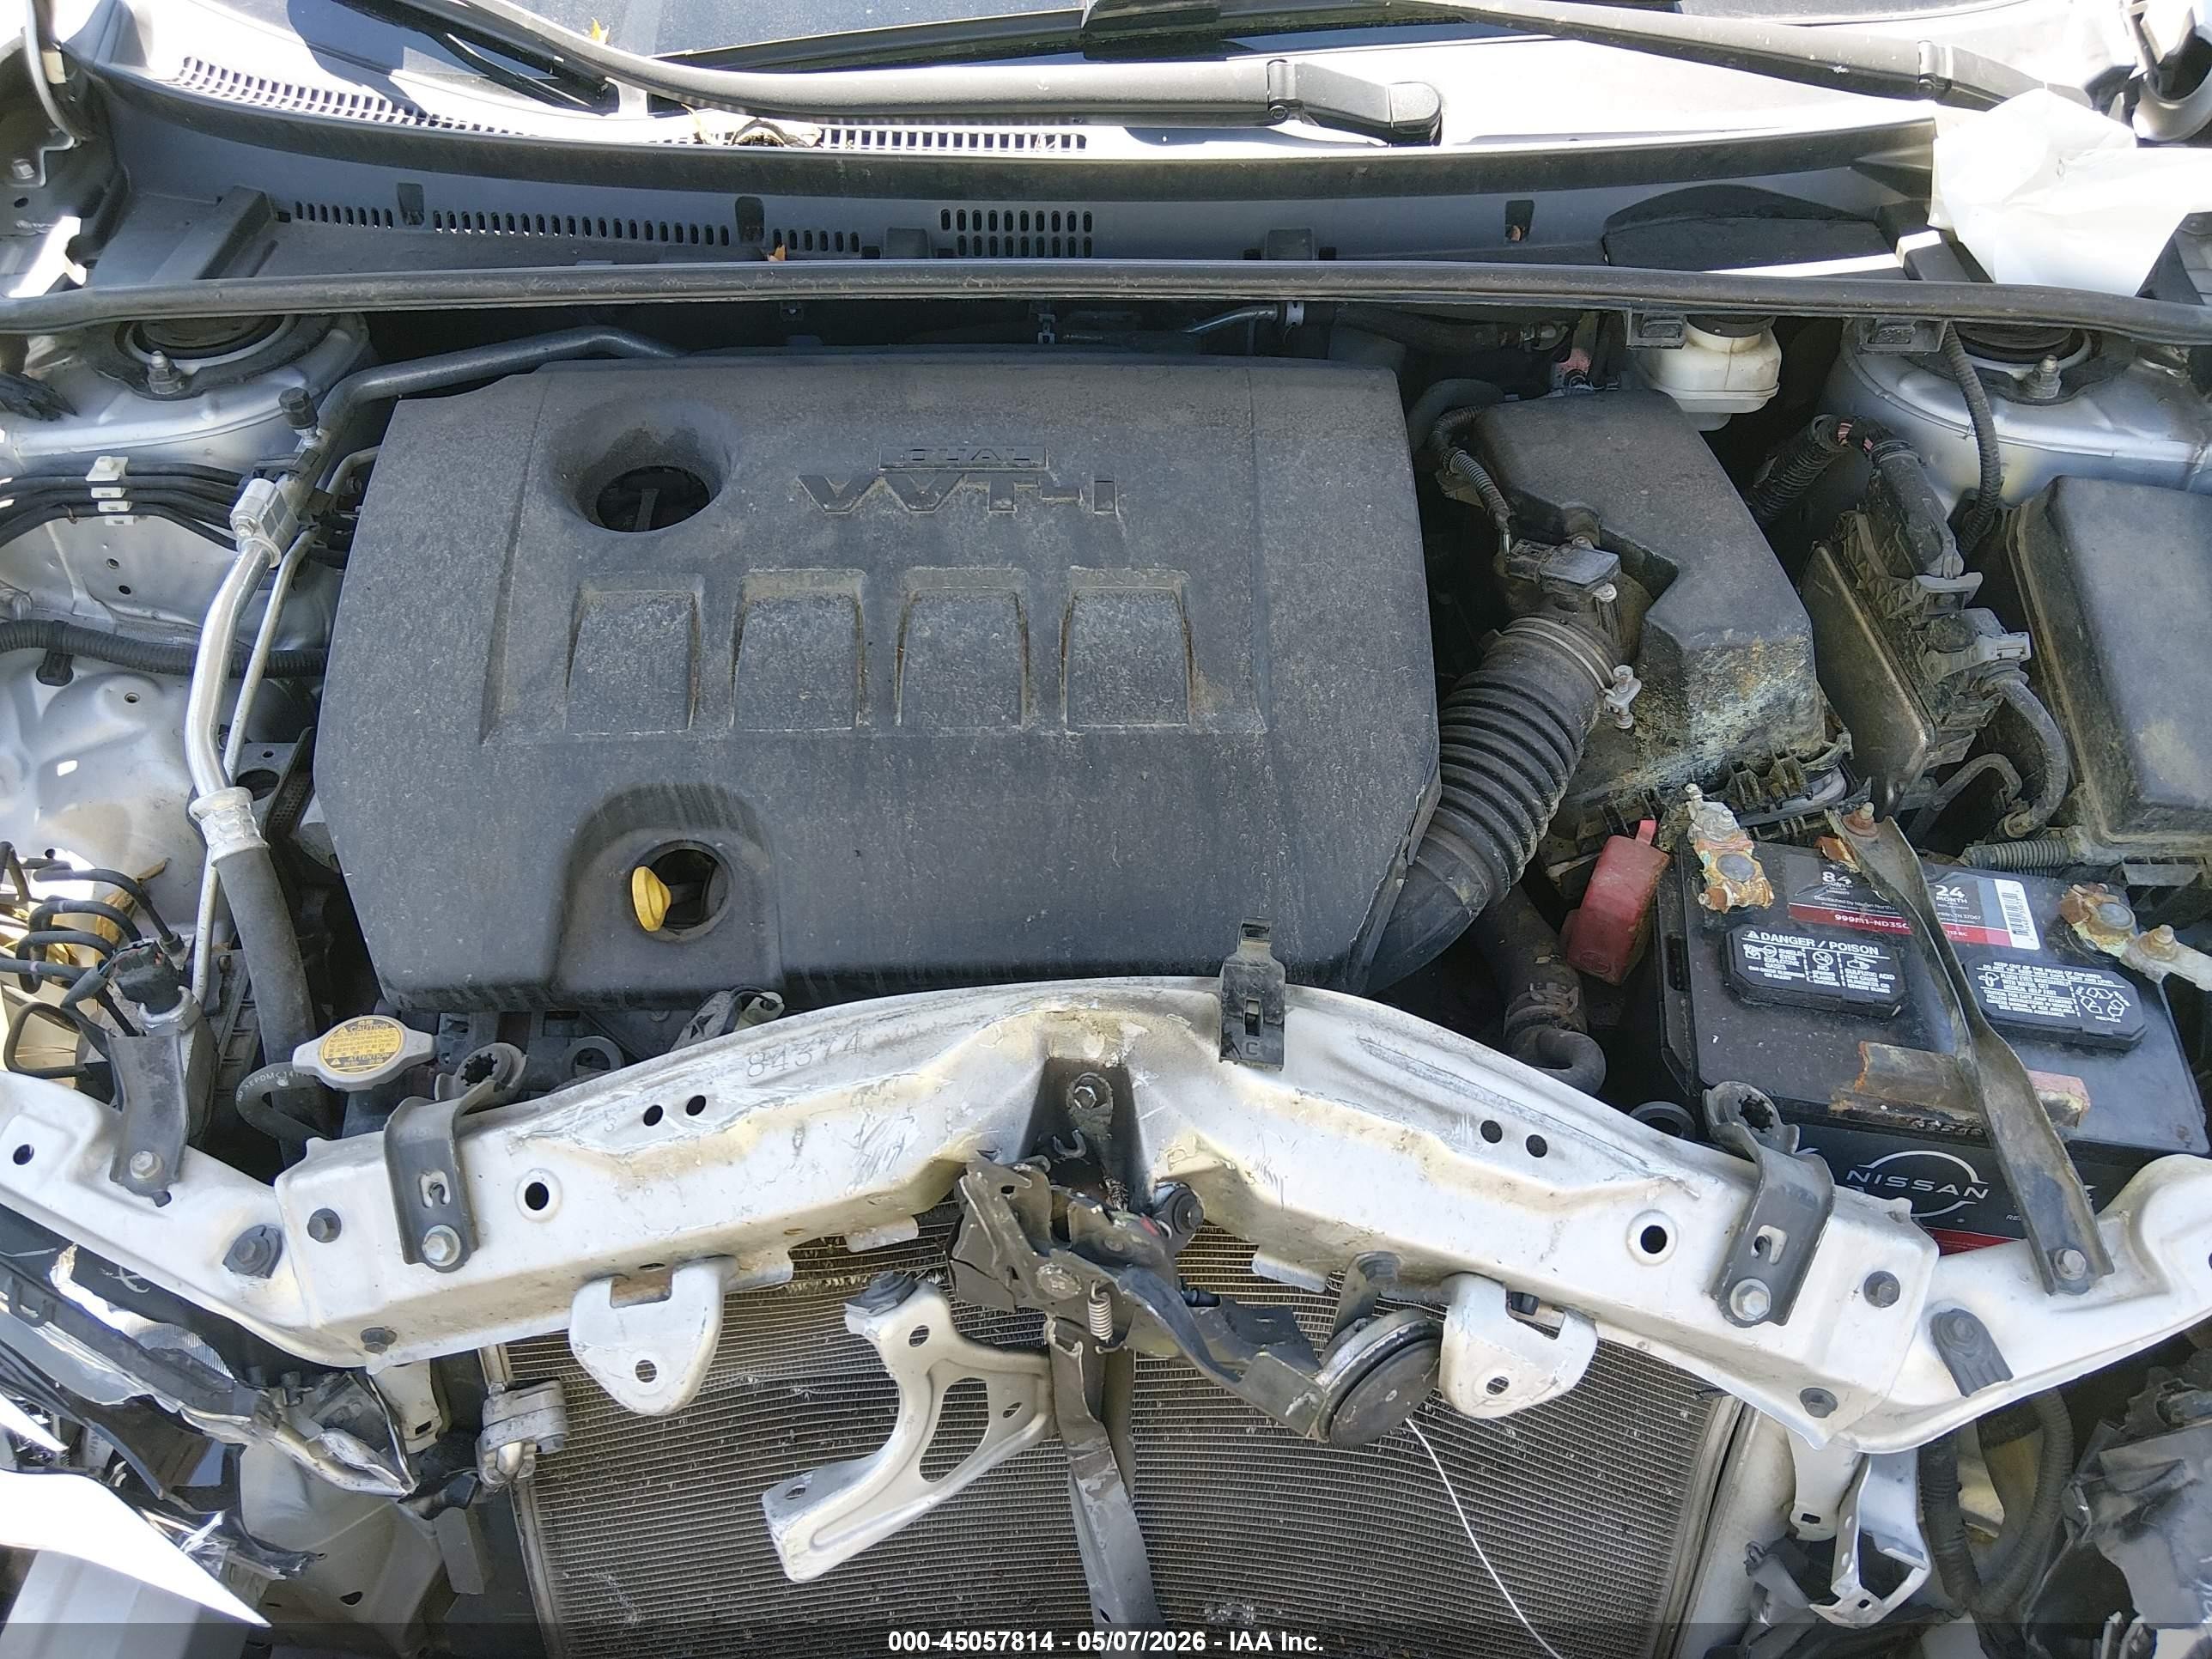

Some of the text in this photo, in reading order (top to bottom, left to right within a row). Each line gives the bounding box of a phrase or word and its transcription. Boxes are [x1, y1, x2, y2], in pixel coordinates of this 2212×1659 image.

[902, 447, 1033, 462] DUAL
[1822, 871, 1852, 885] 84
[1935, 884, 1966, 898] 24
[1814, 895, 1846, 905] Distributed
[1936, 896, 1968, 904] MONTH
[1760, 932, 1815, 948] DANGER
[1829, 941, 1880, 956] POISON
[1778, 948, 1803, 957] SHIELD
[1844, 968, 1878, 978] SULFURIC
[349, 1022, 390, 1032] CAUTION
[347, 1053, 390, 1061] ATTENTION
[1846, 1170, 1990, 1200] NISSAN
